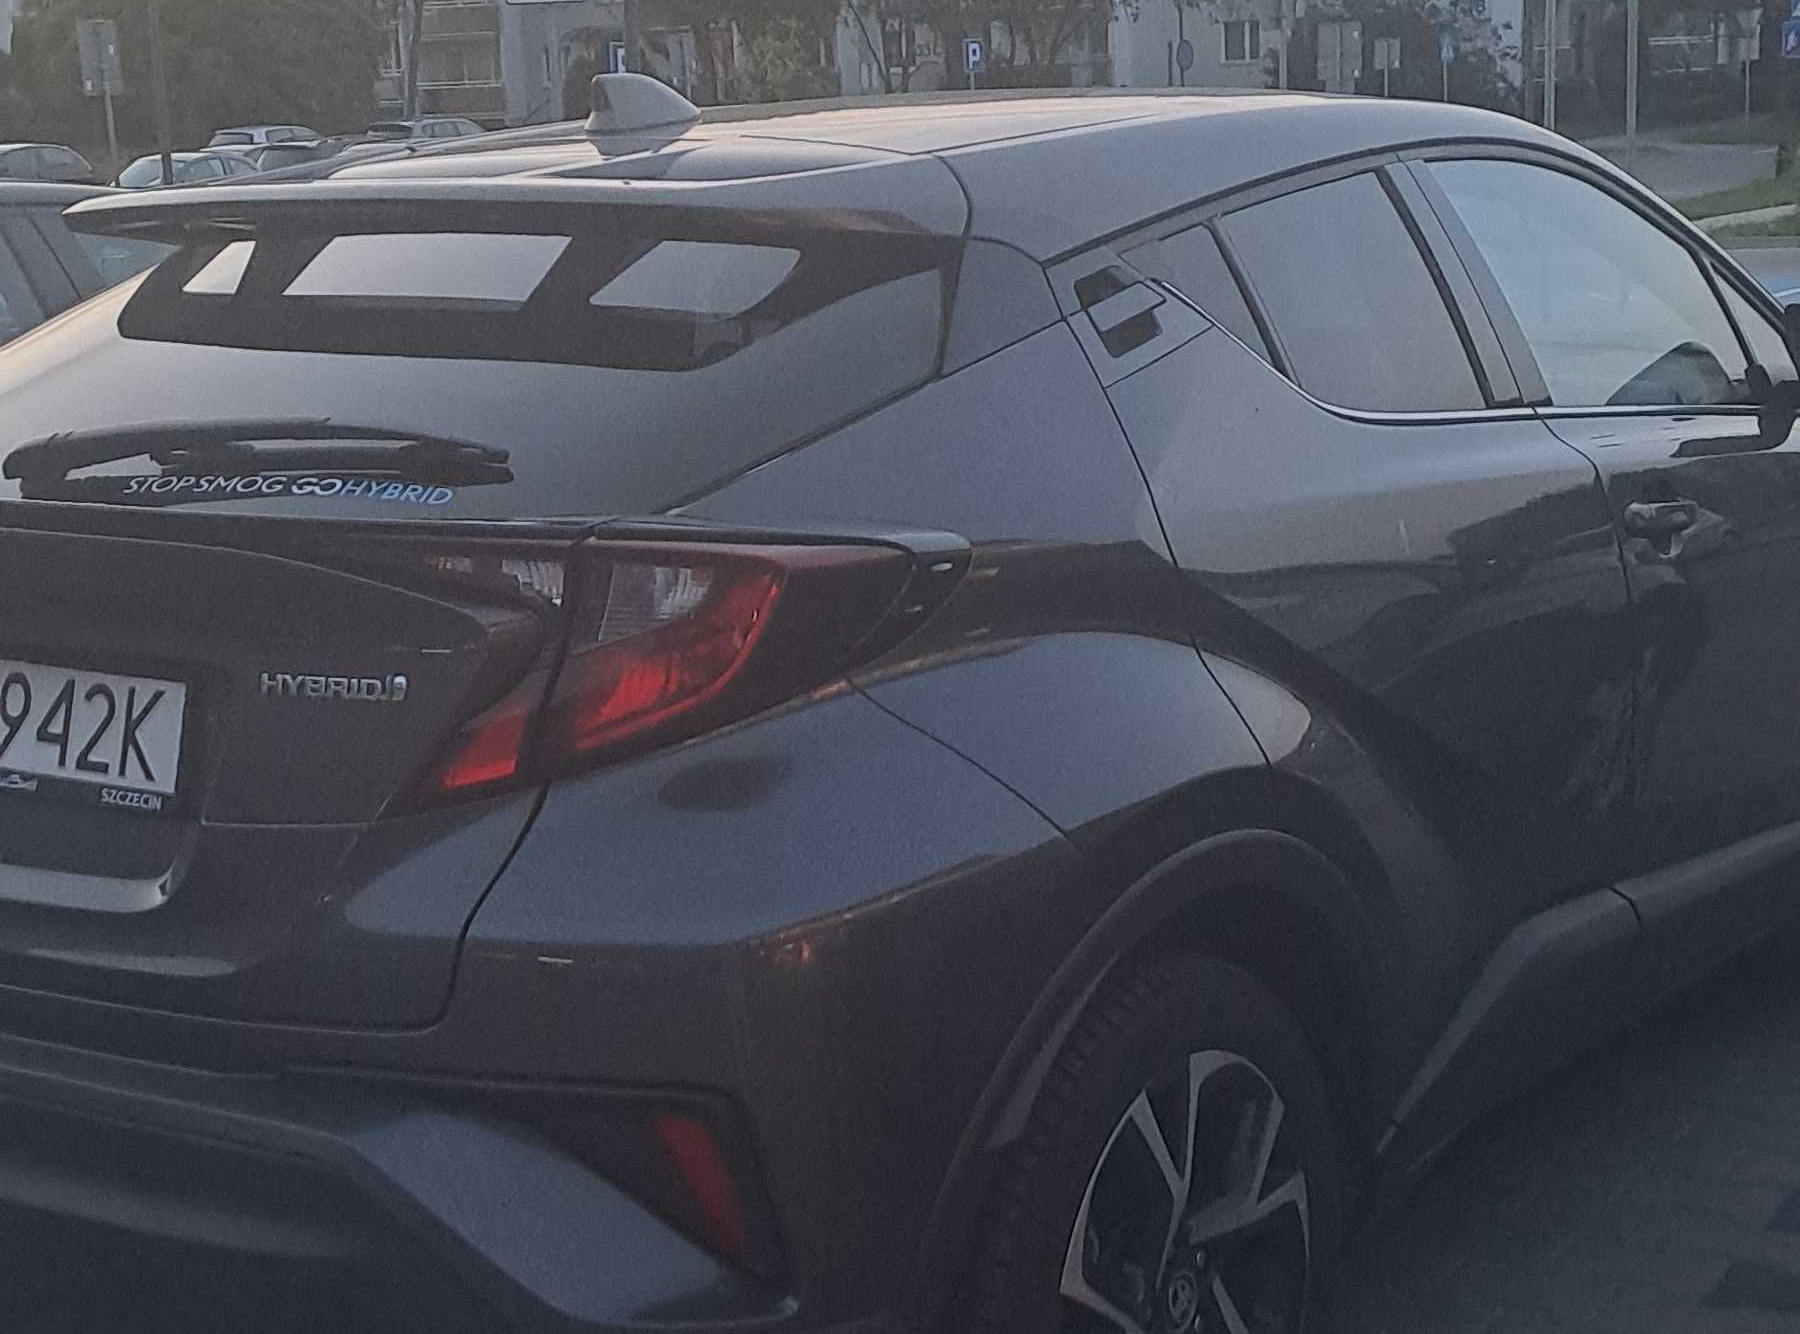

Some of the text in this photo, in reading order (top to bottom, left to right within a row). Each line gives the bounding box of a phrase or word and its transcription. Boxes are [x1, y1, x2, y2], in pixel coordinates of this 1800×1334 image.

[968, 42, 980, 69] P
[260, 672, 383, 701] HYBRID
[101, 787, 162, 810] SZCZECIN
